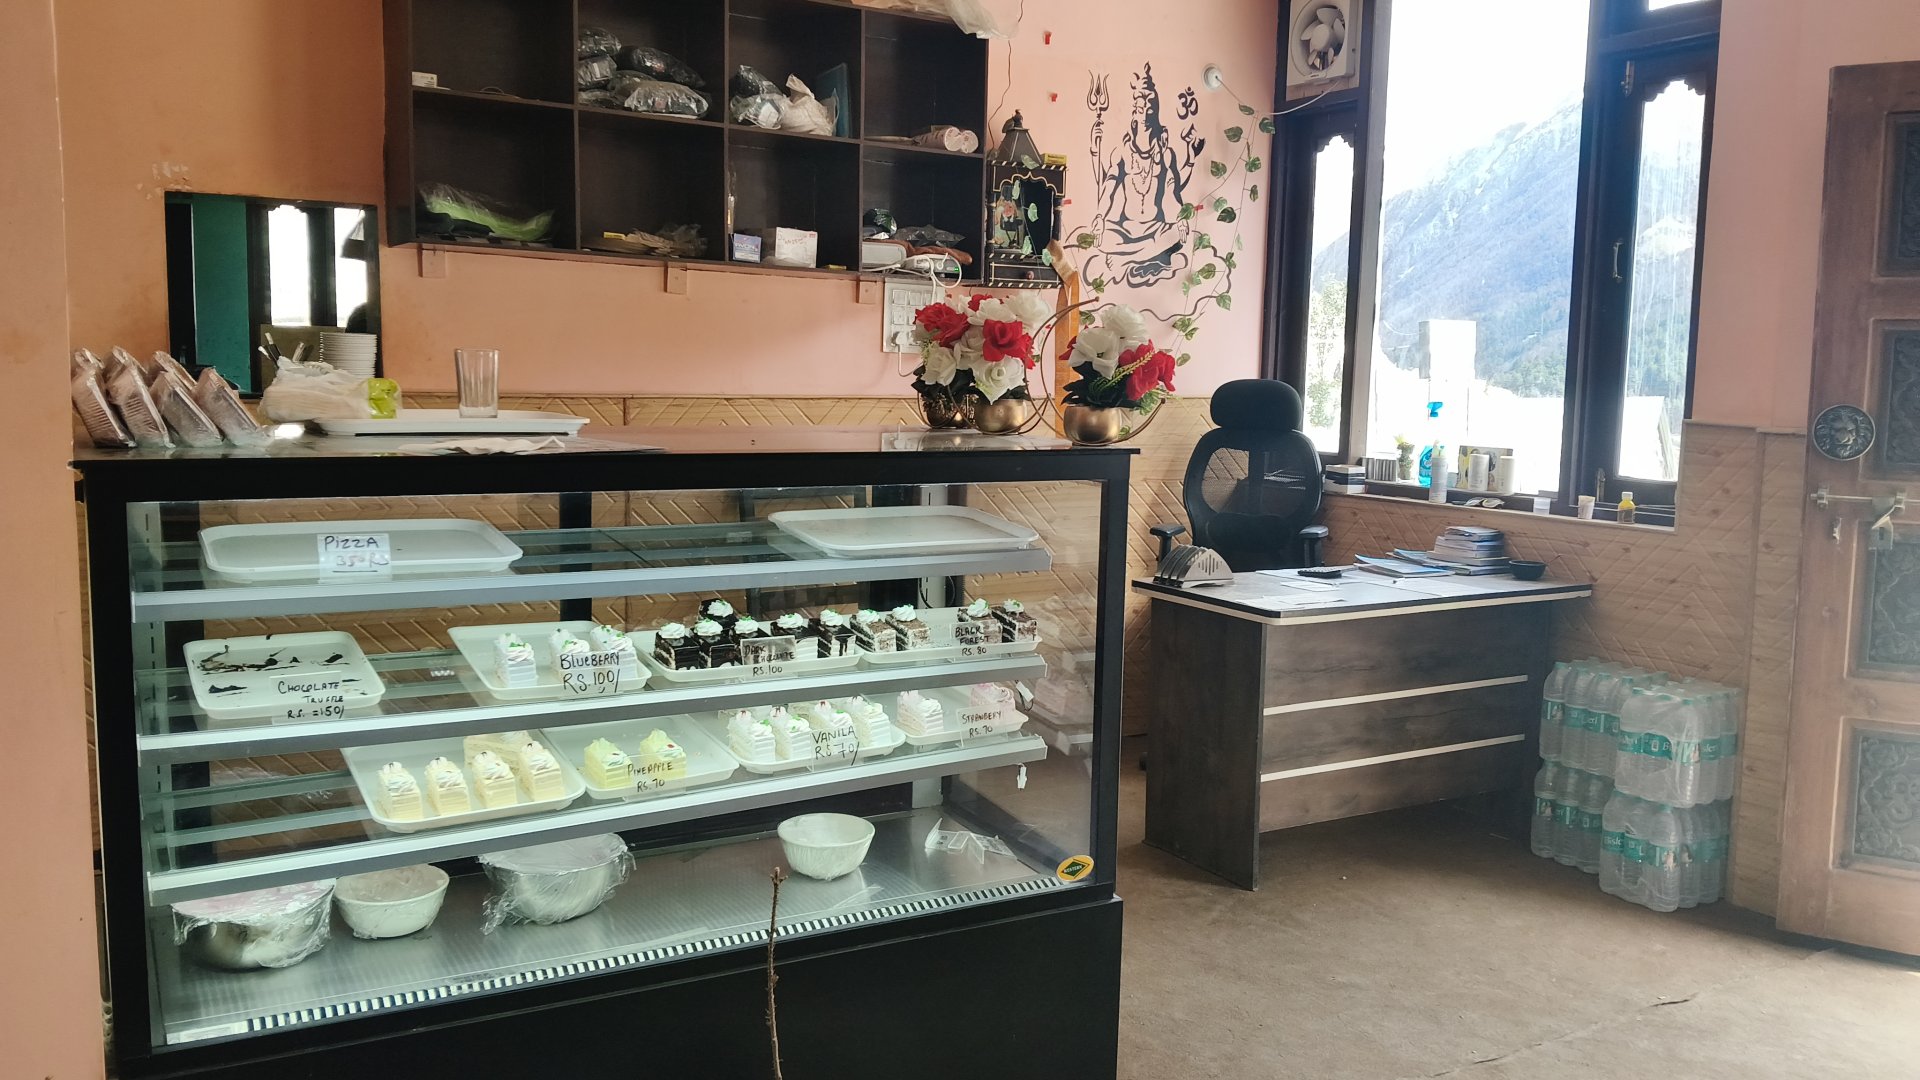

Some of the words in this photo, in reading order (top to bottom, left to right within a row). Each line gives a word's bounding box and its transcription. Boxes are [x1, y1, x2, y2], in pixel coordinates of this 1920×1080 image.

[955, 626, 984, 638] BLACK
[960, 635, 990, 646] FOREST
[277, 680, 341, 695] CHOCOLATE
[811, 725, 858, 744] VANILA
